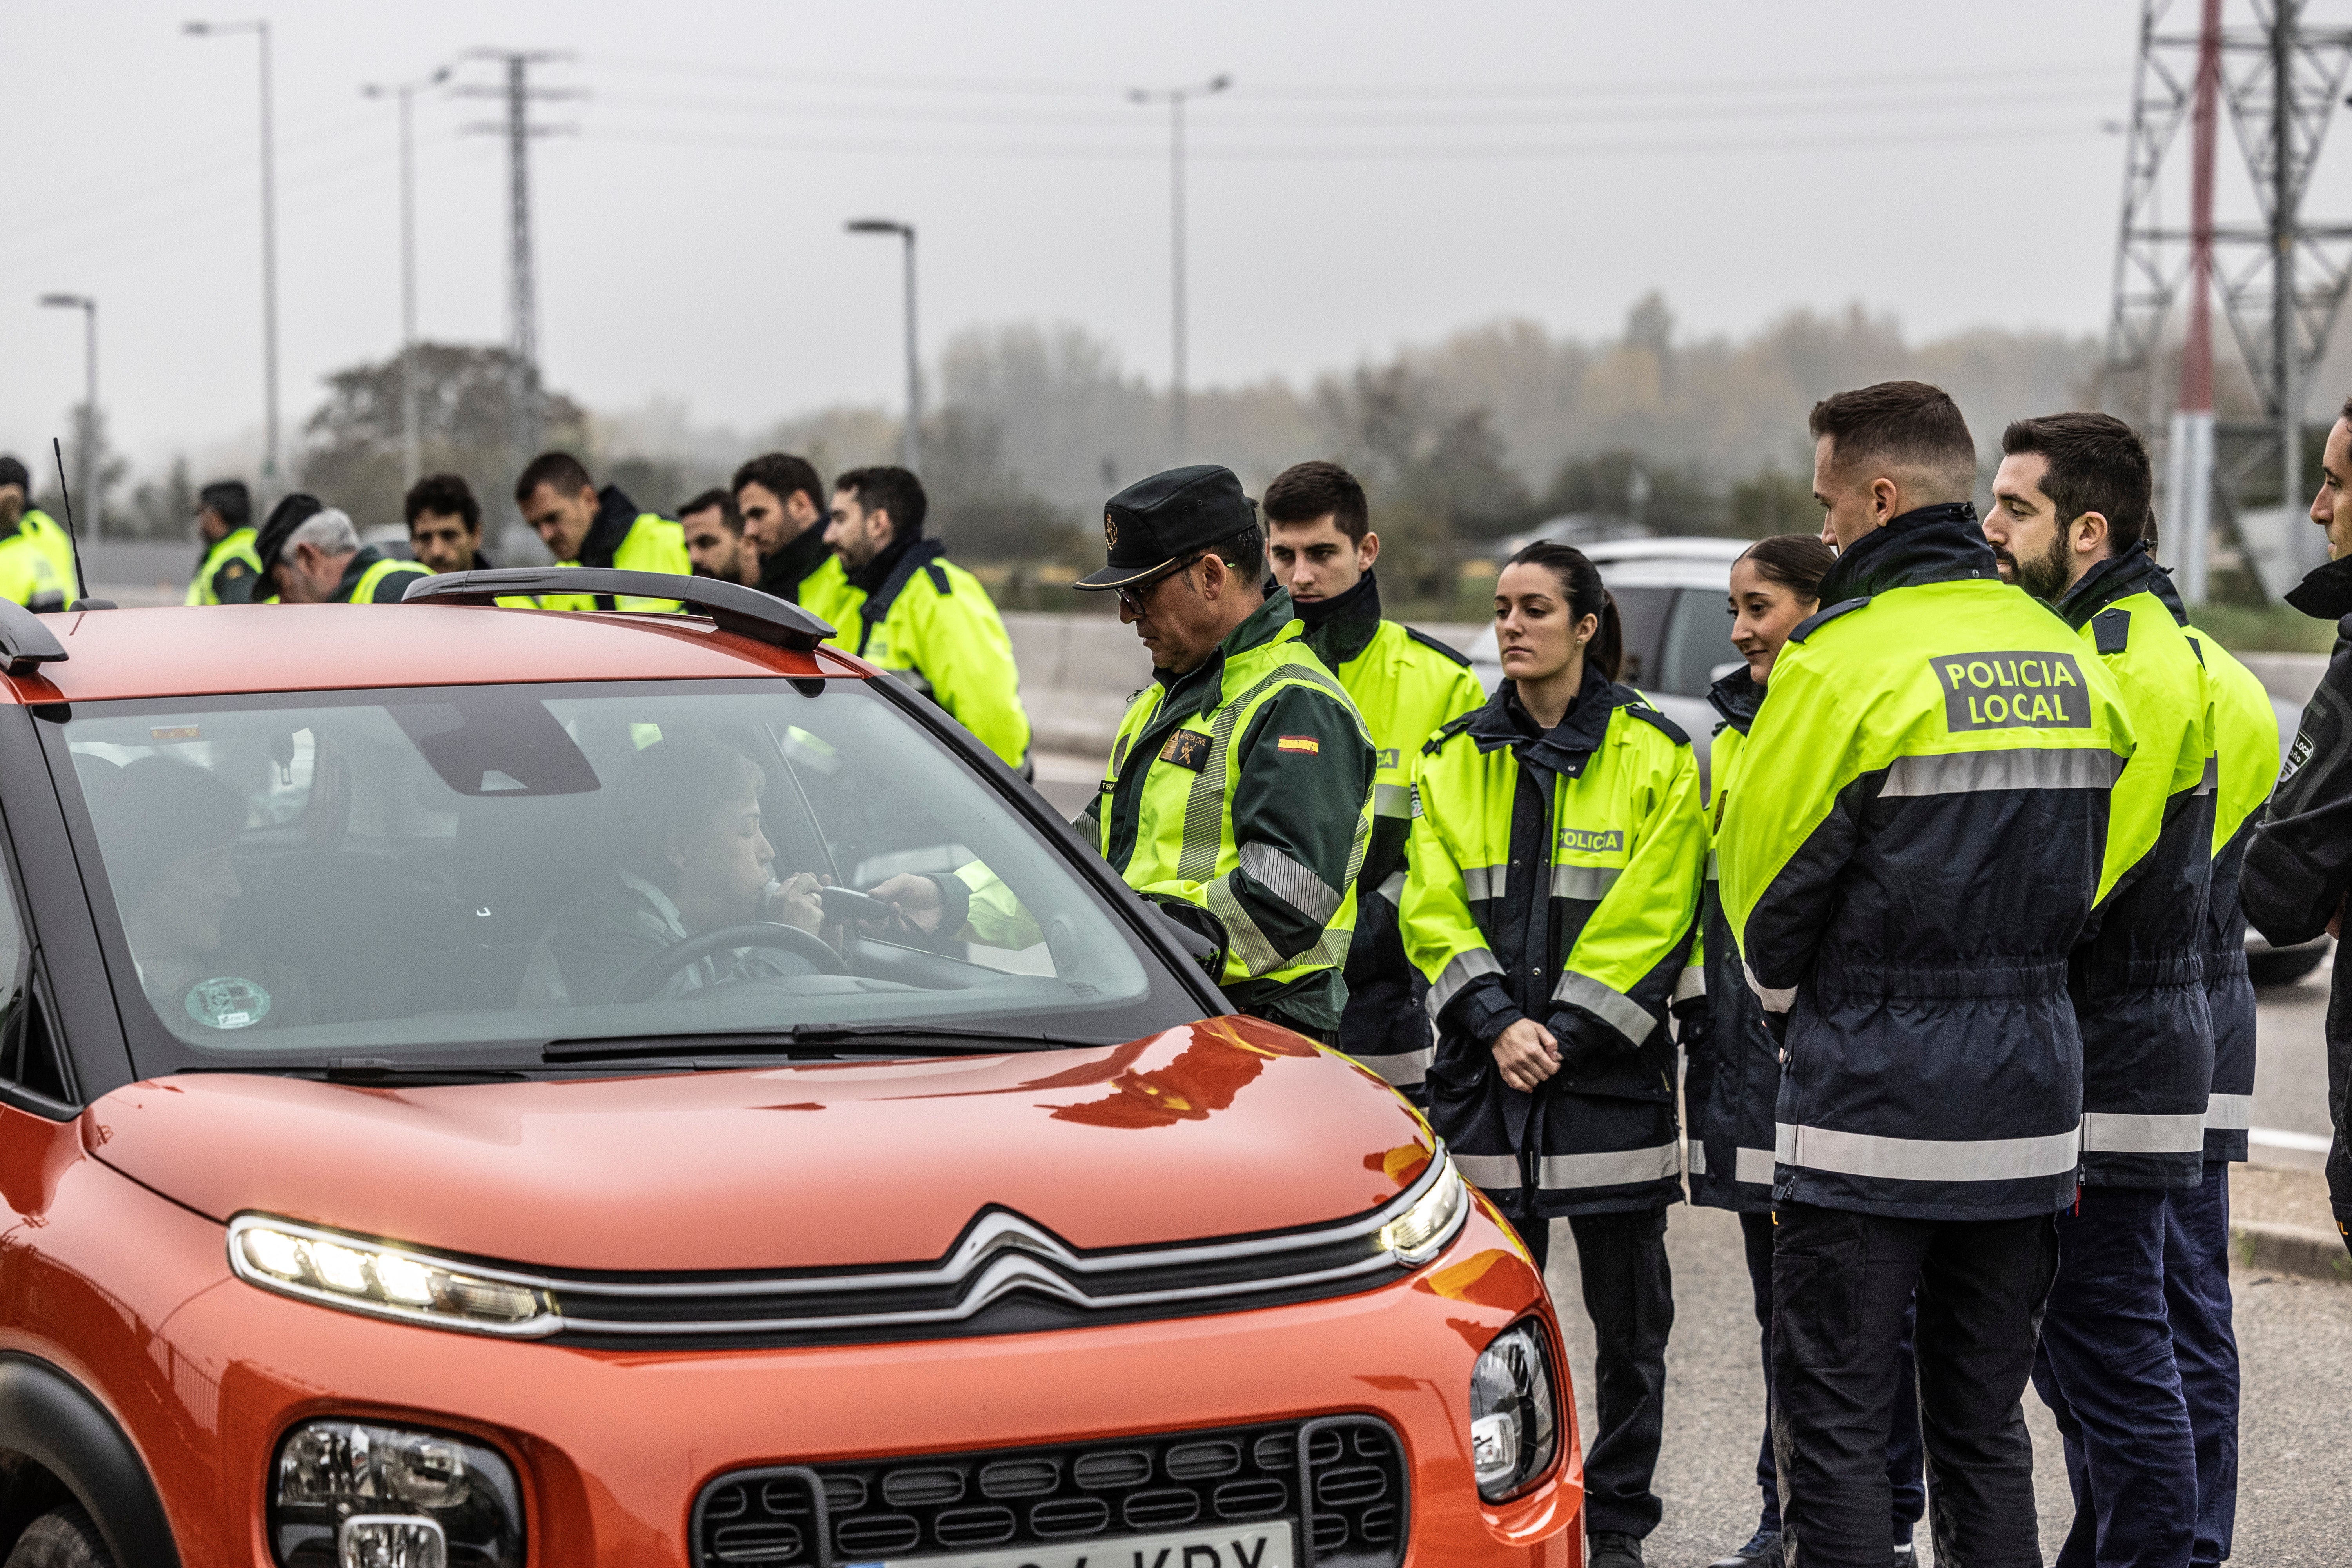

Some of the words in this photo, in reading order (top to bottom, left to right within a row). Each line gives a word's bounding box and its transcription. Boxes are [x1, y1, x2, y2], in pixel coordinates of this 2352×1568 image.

[1945, 660, 2077, 690] POLICIA
[1968, 693, 2069, 724] LOCAL
[1180, 732, 1196, 743] GUARDIA
[1195, 737, 1206, 747] CIVIL
[2295, 737, 2312, 758] Local
